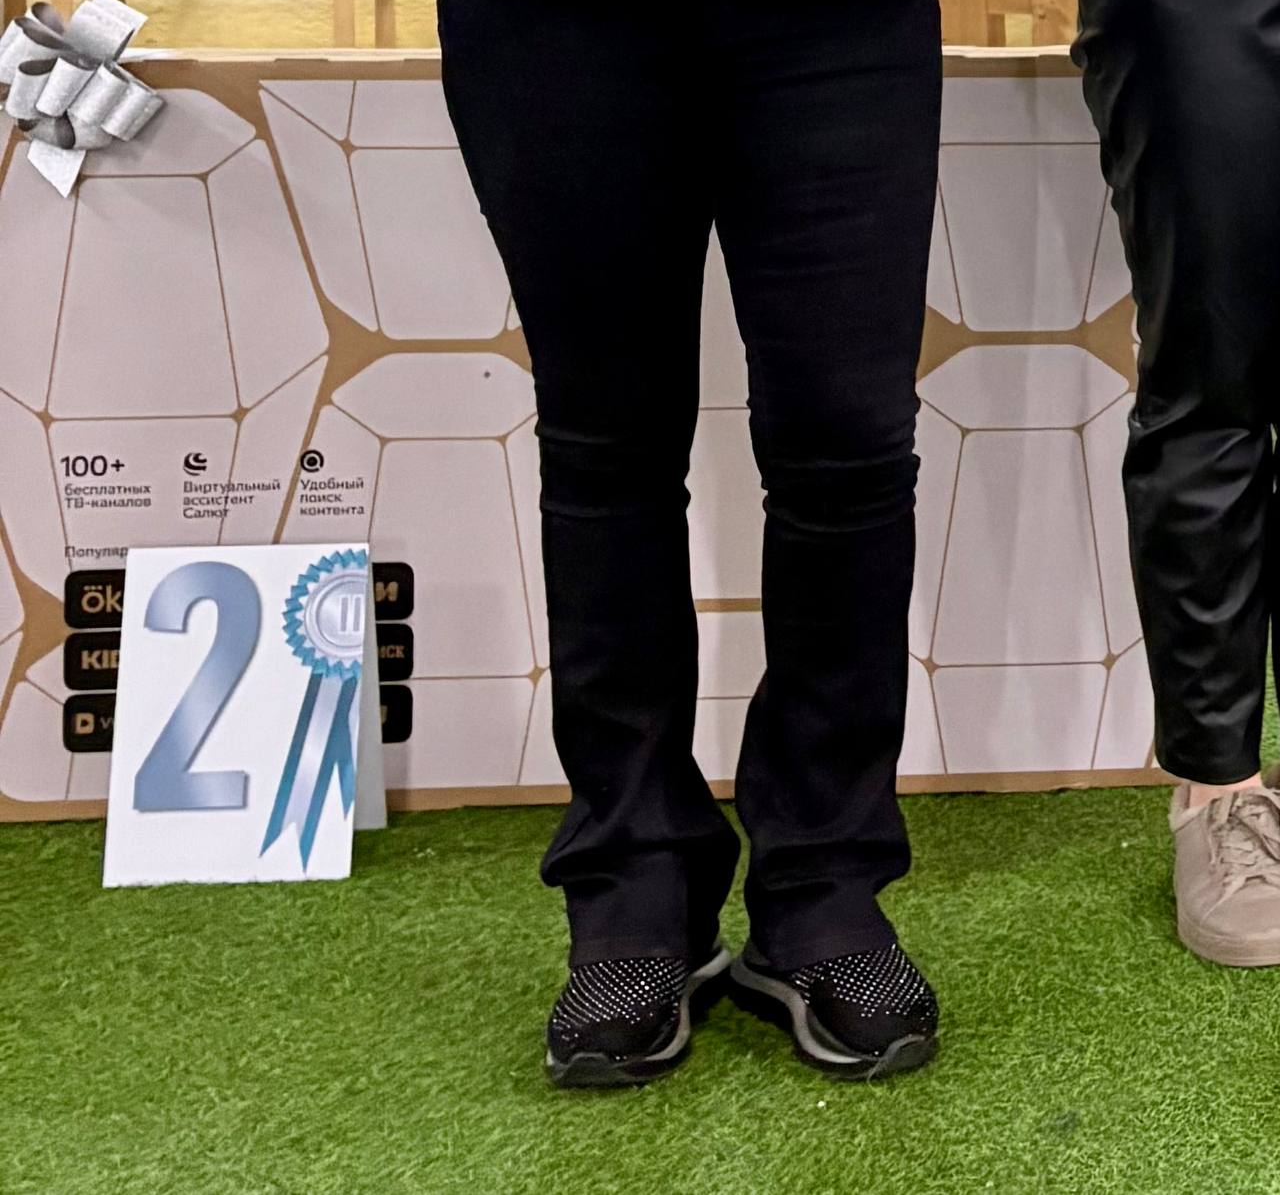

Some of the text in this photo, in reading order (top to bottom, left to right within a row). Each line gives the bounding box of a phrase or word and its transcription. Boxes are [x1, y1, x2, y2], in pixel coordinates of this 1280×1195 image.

[61, 454, 126, 478] 100+
[64, 483, 152, 496] бесплатных
[182, 479, 281, 494] Виртуальный
[300, 476, 365, 492] Удобный
[64, 496, 152, 509] ТВ-каналов
[183, 494, 255, 507] ассистент
[300, 492, 343, 504] поиск
[183, 506, 230, 519] Салют
[300, 505, 366, 516] контента
[133, 560, 263, 813] 2
